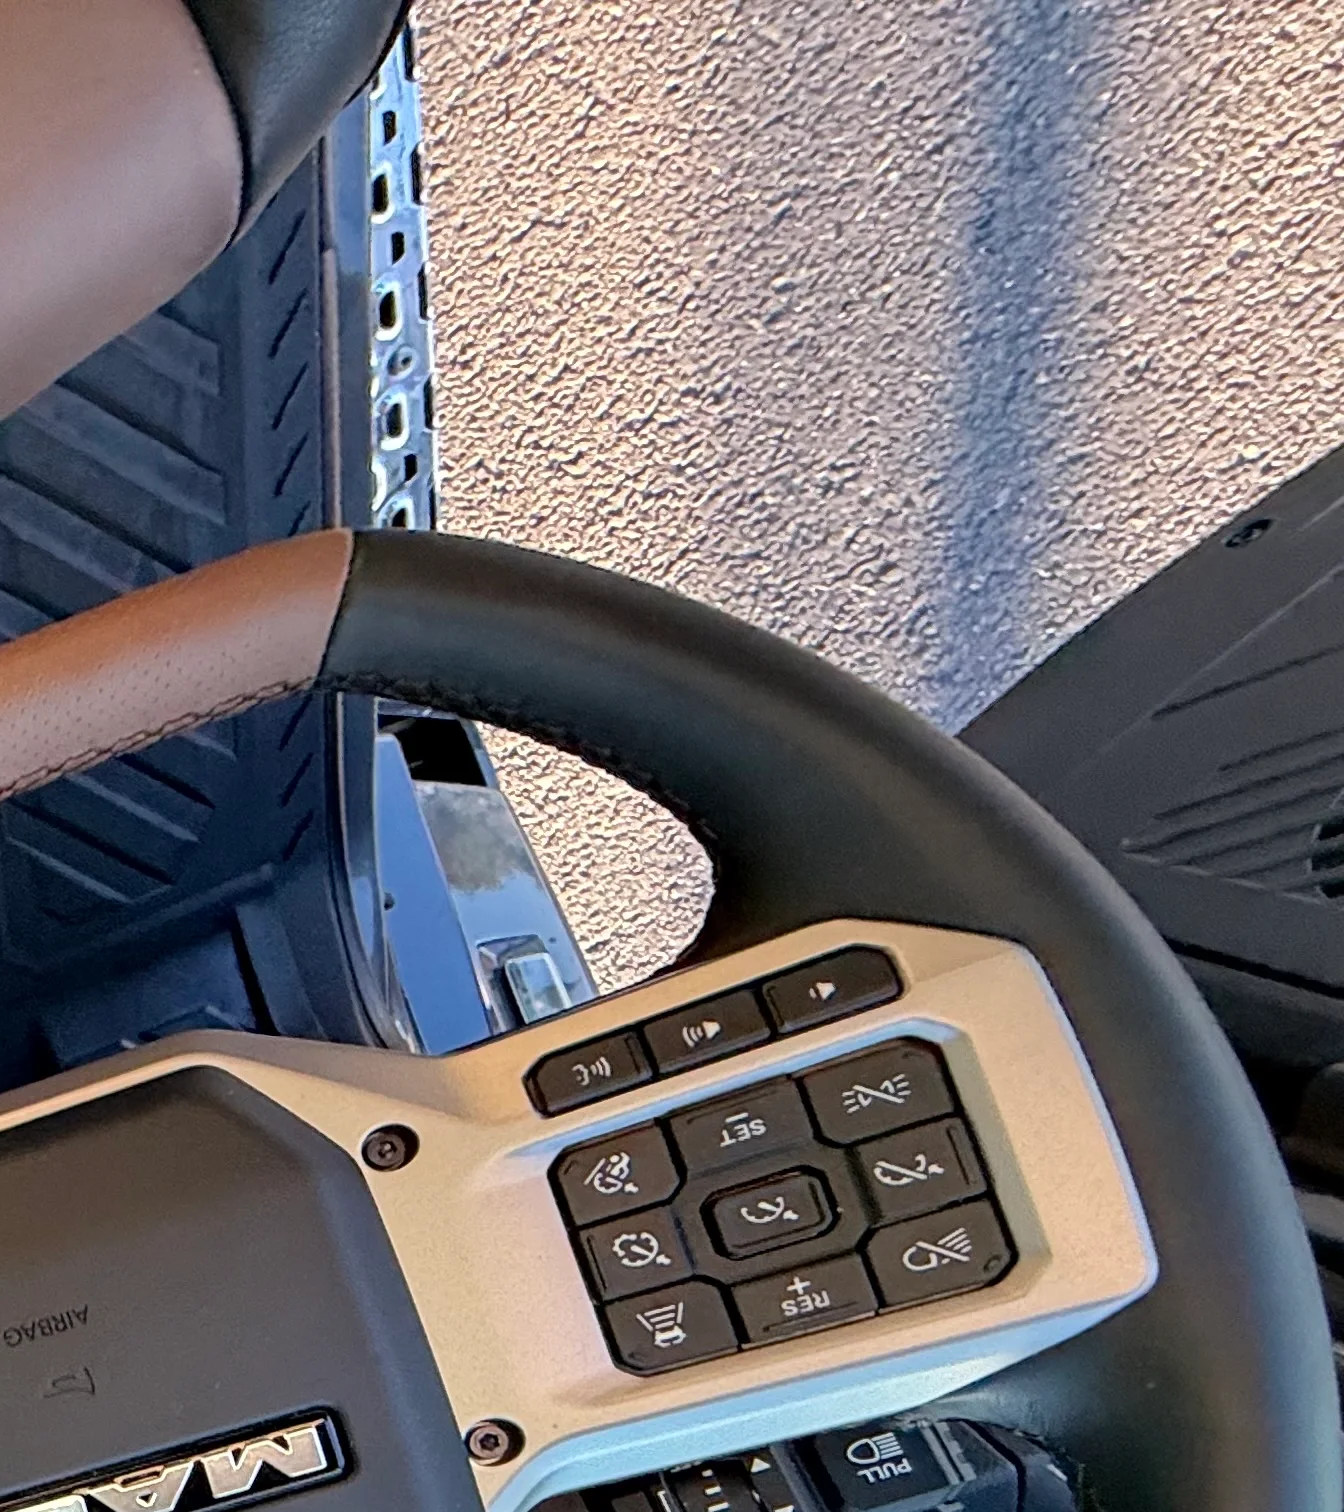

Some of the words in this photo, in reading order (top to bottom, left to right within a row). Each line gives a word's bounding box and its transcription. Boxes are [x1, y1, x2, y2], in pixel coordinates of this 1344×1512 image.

[719, 1118, 767, 1147] SET
[780, 1290, 831, 1317] RES
[3, 1304, 89, 1348] AIRBAG
[856, 1458, 912, 1483] PULL
